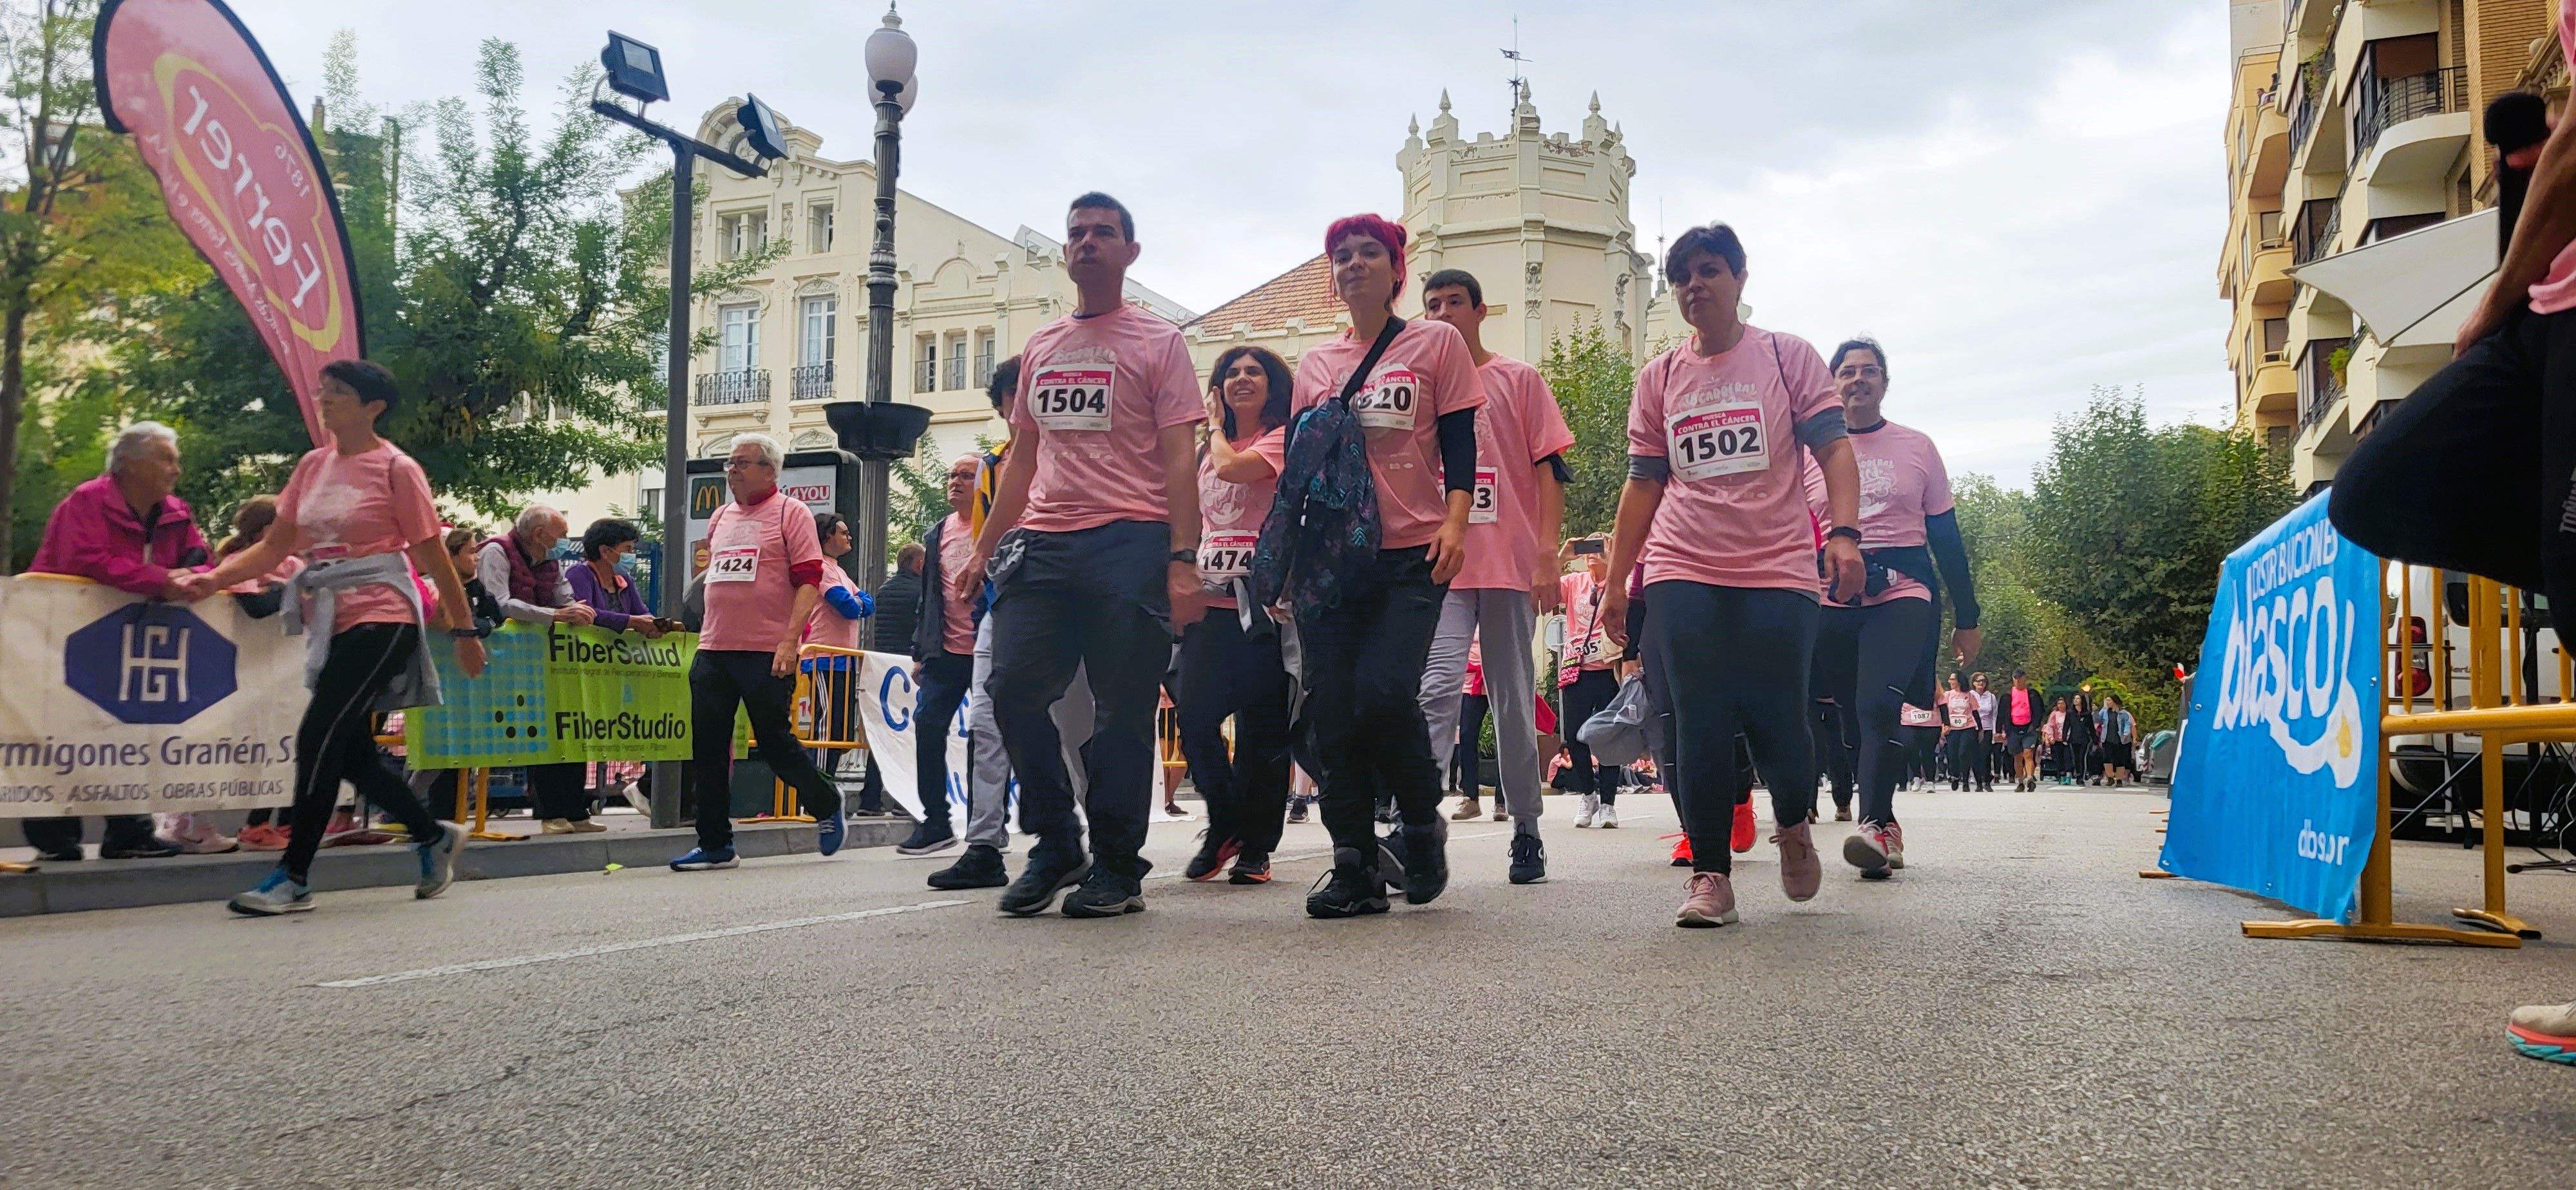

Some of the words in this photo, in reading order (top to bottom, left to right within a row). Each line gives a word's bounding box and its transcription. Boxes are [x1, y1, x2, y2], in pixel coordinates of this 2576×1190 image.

[1037, 388, 1106, 413] 1504
[1678, 420, 1710, 434] CONTRA
[1721, 415, 1756, 426] CÁNCER
[1678, 426, 1760, 464] 1502
[714, 558, 753, 574] 1424
[1202, 550, 1252, 571] 1474
[549, 634, 682, 667] FiberSalud
[555, 711, 686, 740] FiberStudio
[0, 784, 54, 802] RIDOS
[68, 783, 150, 802] ASFALTOS
[162, 782, 216, 799] OBRAS
[220, 779, 284, 797] PÚBLICAS
